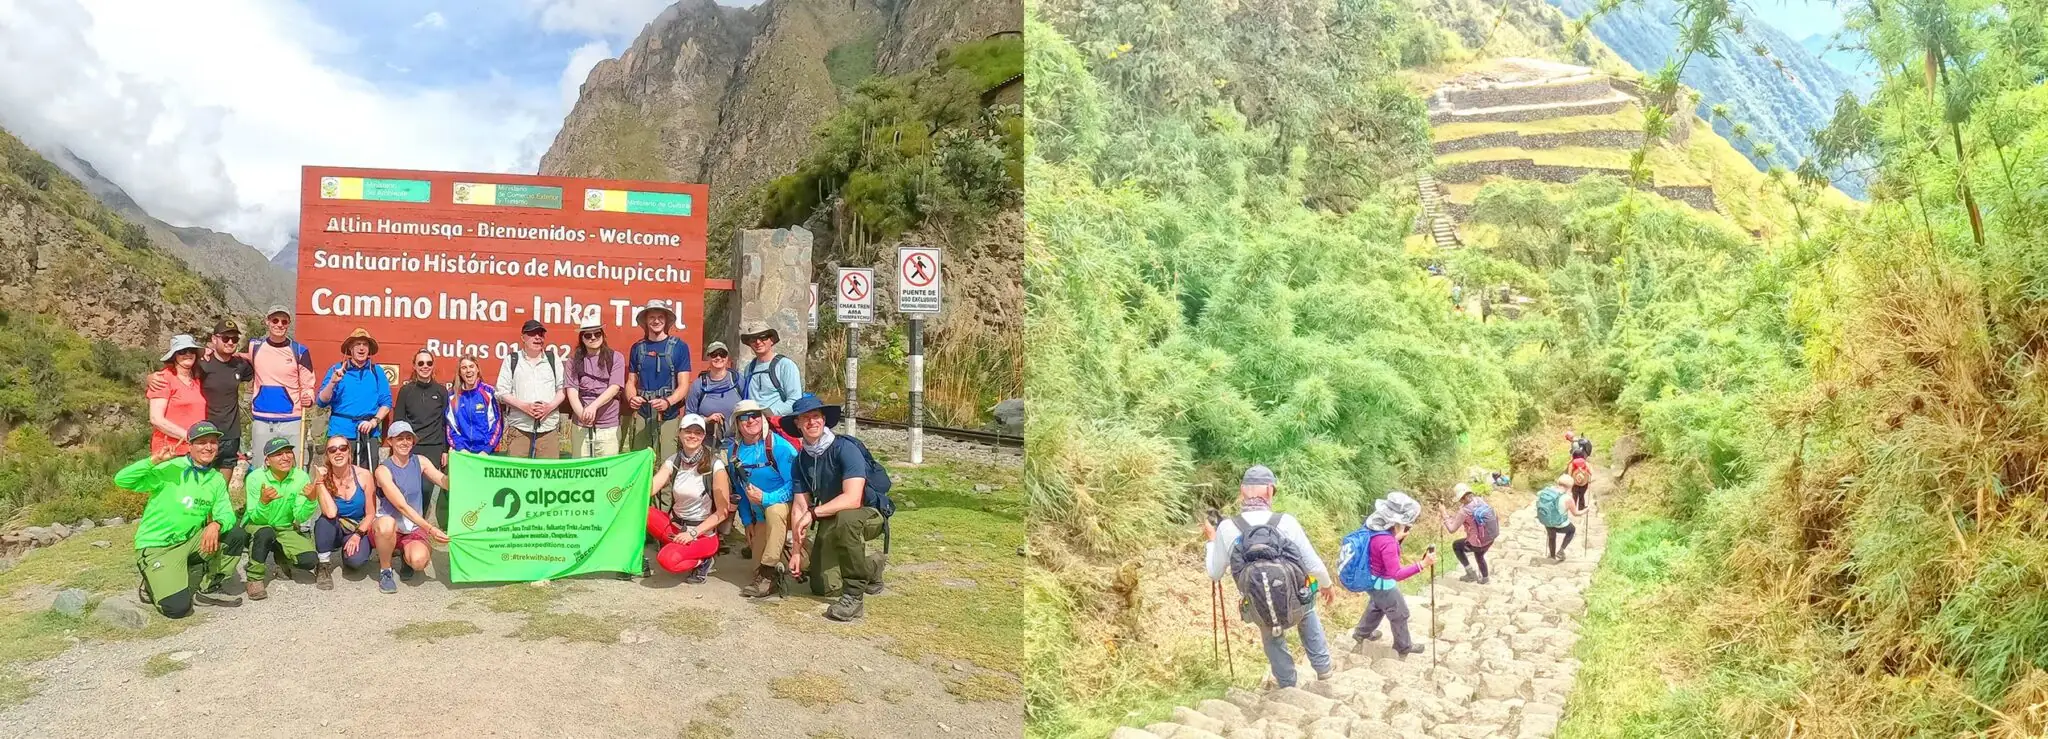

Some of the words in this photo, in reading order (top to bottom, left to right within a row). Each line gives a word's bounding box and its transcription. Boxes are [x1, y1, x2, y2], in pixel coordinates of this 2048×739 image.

[496, 184, 528, 193] Ministerio
[325, 216, 373, 234] Allin
[377, 218, 464, 241] Hamusqa
[477, 221, 586, 243] Bienvenidos
[598, 227, 681, 248] Welcome
[313, 249, 421, 272] Santuario
[424, 252, 520, 276] Histórico
[523, 257, 550, 278] de
[552, 259, 692, 286] Machupicchu
[310, 286, 434, 320] Camino
[437, 291, 509, 323] Inka
[532, 294, 603, 326] Inka
[426, 338, 490, 360] Rutas
[484, 466, 529, 479] TREKKING
[530, 468, 542, 479] TO
[543, 466, 608, 479] MACHUPICCHU
[525, 487, 595, 508] alpaca
[525, 509, 595, 518] EXPEDITIONS
